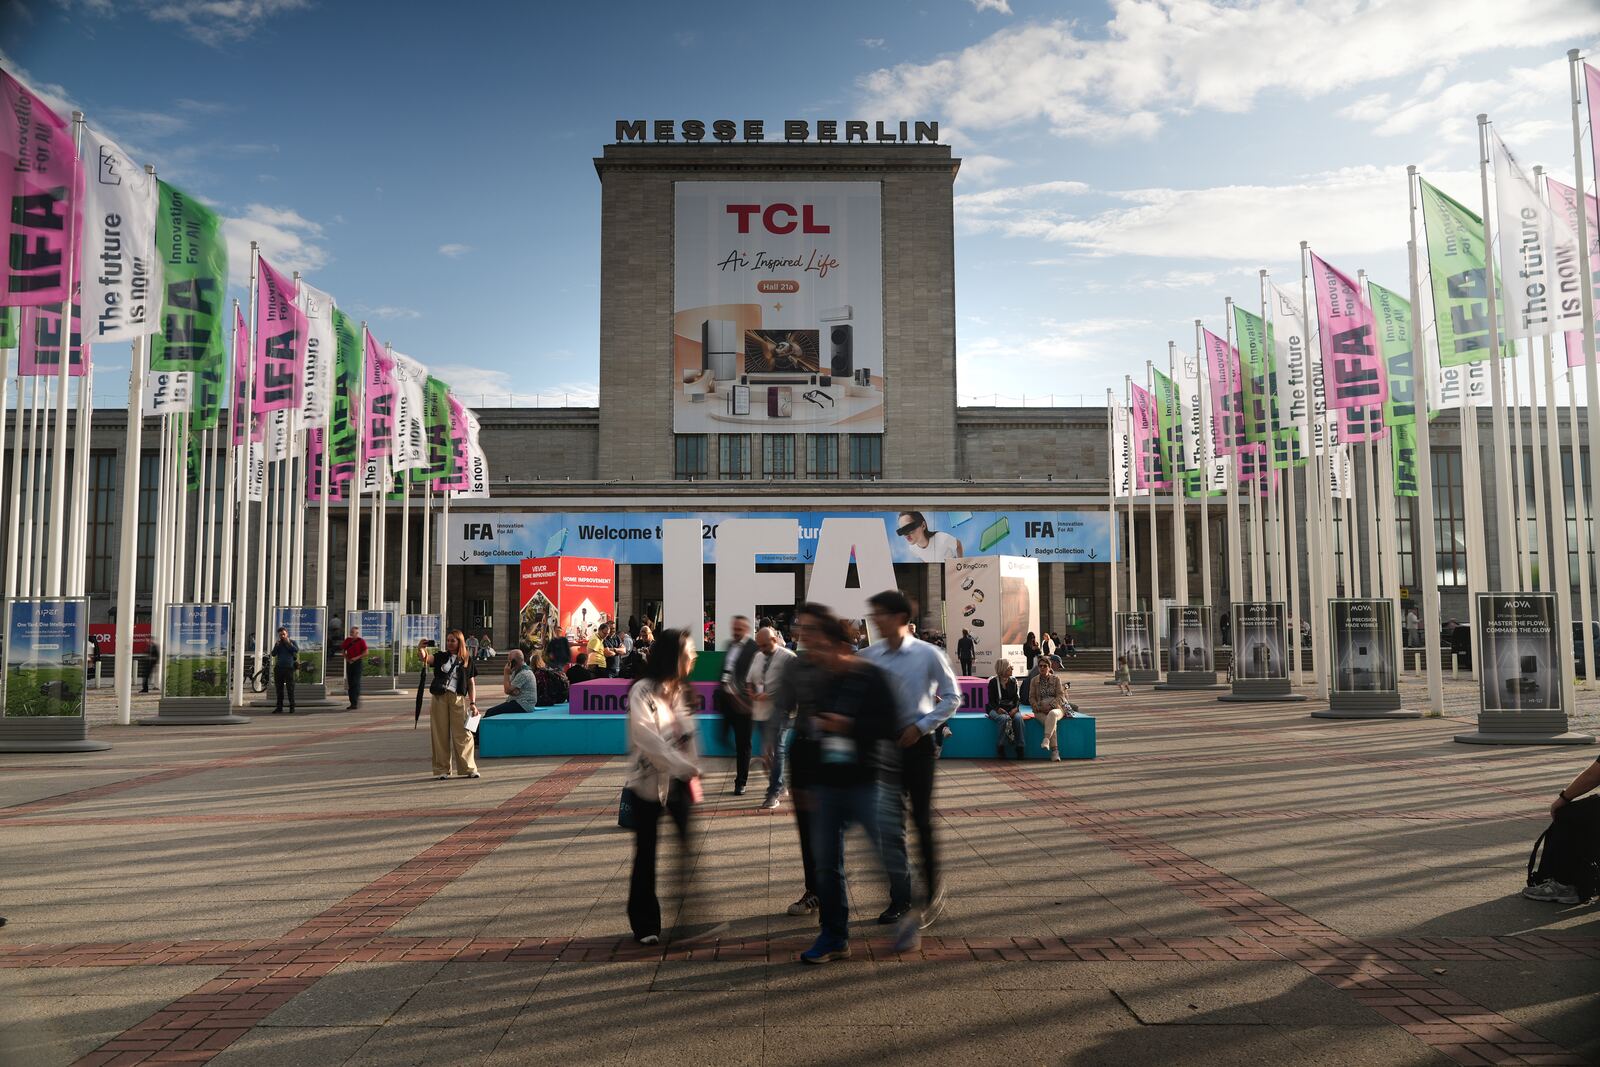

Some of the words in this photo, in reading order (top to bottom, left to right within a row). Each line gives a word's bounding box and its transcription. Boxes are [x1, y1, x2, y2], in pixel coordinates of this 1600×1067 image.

[615, 120, 764, 141] MESSE
[784, 120, 939, 142] BERLIN
[169, 191, 184, 264] Innovation
[726, 203, 830, 234] TCL
[8, 187, 69, 293] IFA
[98, 212, 122, 286] future
[186, 244, 201, 265] For
[1519, 207, 1545, 277] future
[751, 251, 803, 273] Inspired
[803, 249, 840, 278] Life
[763, 282, 779, 292] Hall
[780, 282, 794, 292] 21a
[98, 291, 123, 336] The
[164, 278, 214, 362] IFA
[1522, 281, 1549, 330] The
[1557, 298, 1582, 320] is
[263, 329, 300, 404] IFA
[1288, 334, 1304, 386] future
[1332, 324, 1380, 399] IFA
[153, 373, 170, 409] The
[1441, 368, 1461, 403] The
[1466, 382, 1484, 397] is
[370, 393, 393, 450] IFA
[1290, 388, 1306, 422] The
[364, 462, 377, 489] The
[472, 480, 484, 493] is
[1213, 464, 1225, 486] The
[463, 523, 494, 541] IFA
[578, 524, 647, 541] Welcome
[1024, 521, 1054, 538] IFA
[963, 563, 988, 571] RingConn
[662, 517, 898, 652] IFA
